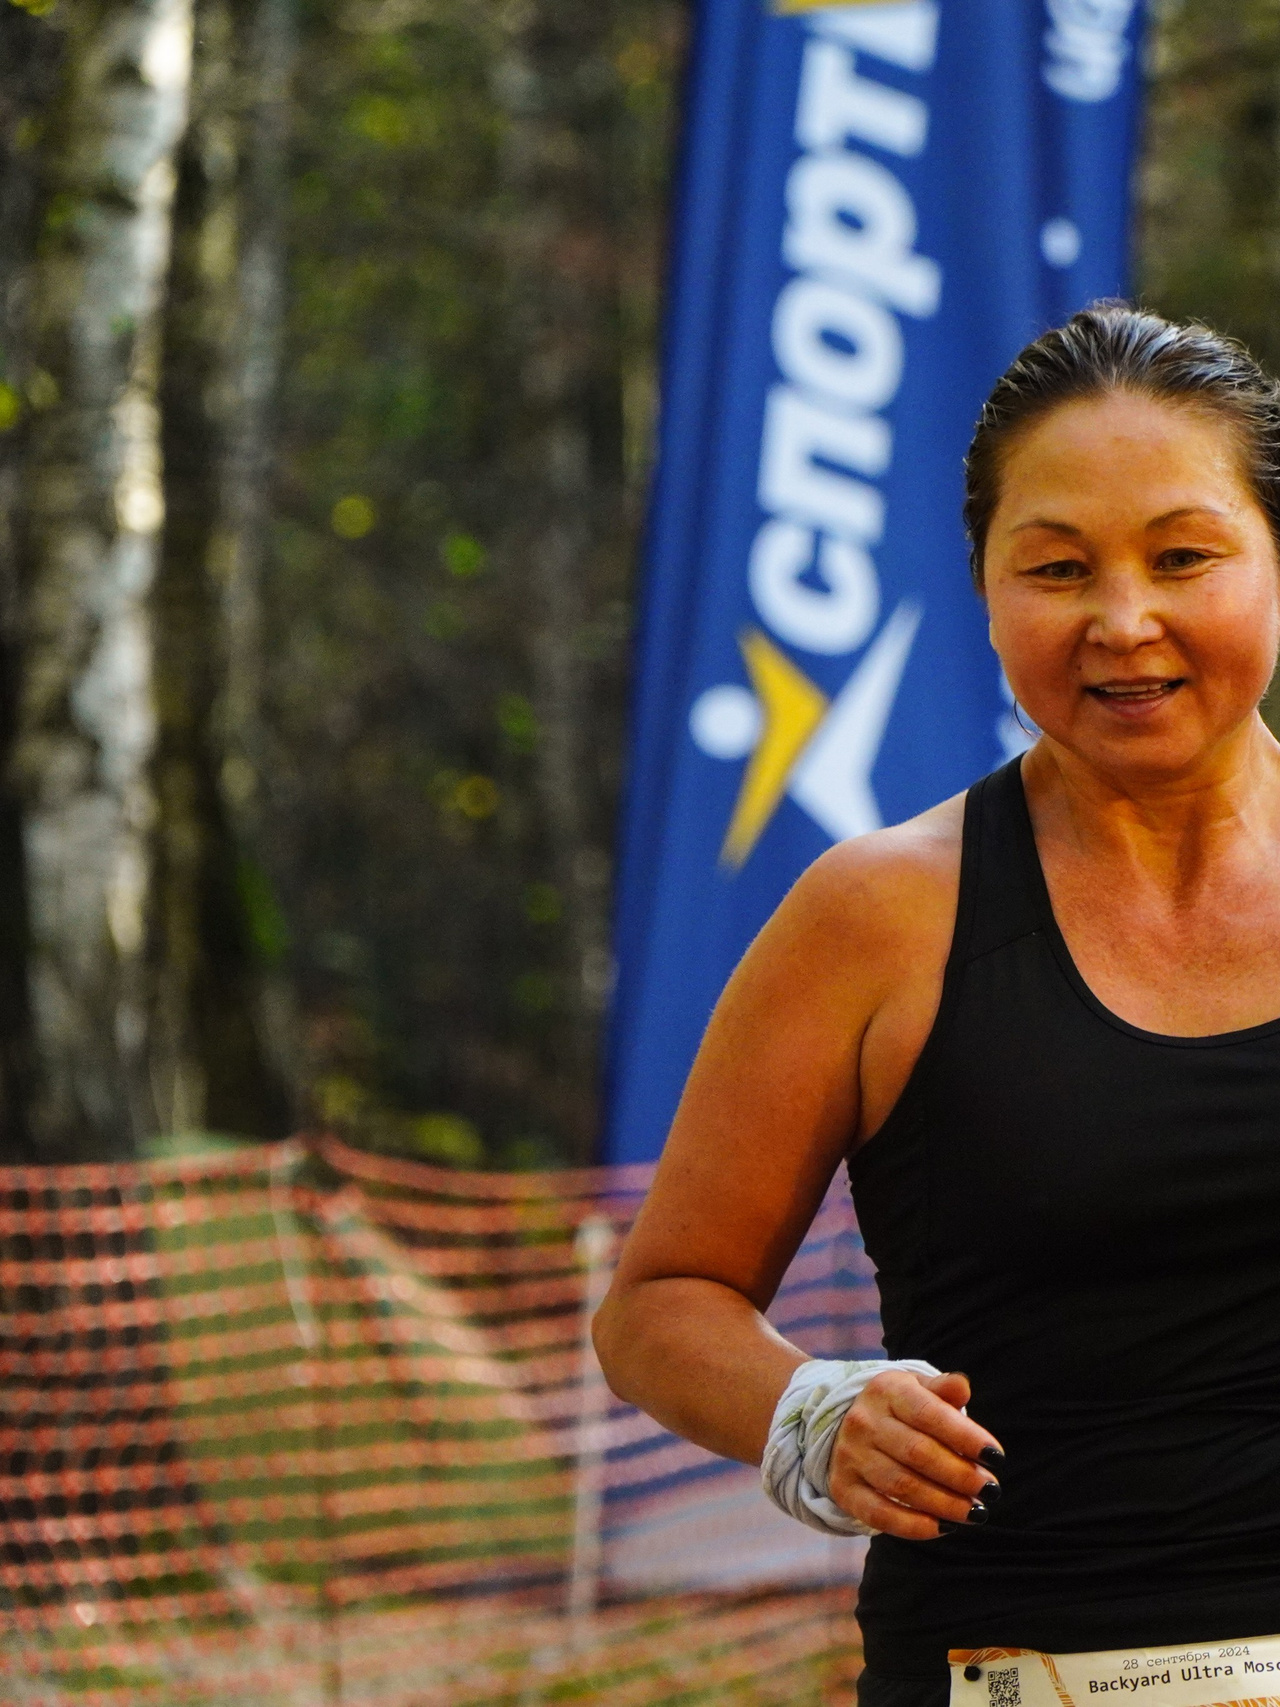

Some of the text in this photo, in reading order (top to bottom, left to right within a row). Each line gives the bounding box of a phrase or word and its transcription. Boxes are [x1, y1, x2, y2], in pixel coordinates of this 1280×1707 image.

[1122, 1645, 1251, 1671] 28 сентября 2024
[1088, 1670, 1171, 1694] Backyard
[1181, 1664, 1234, 1682] Ultra
